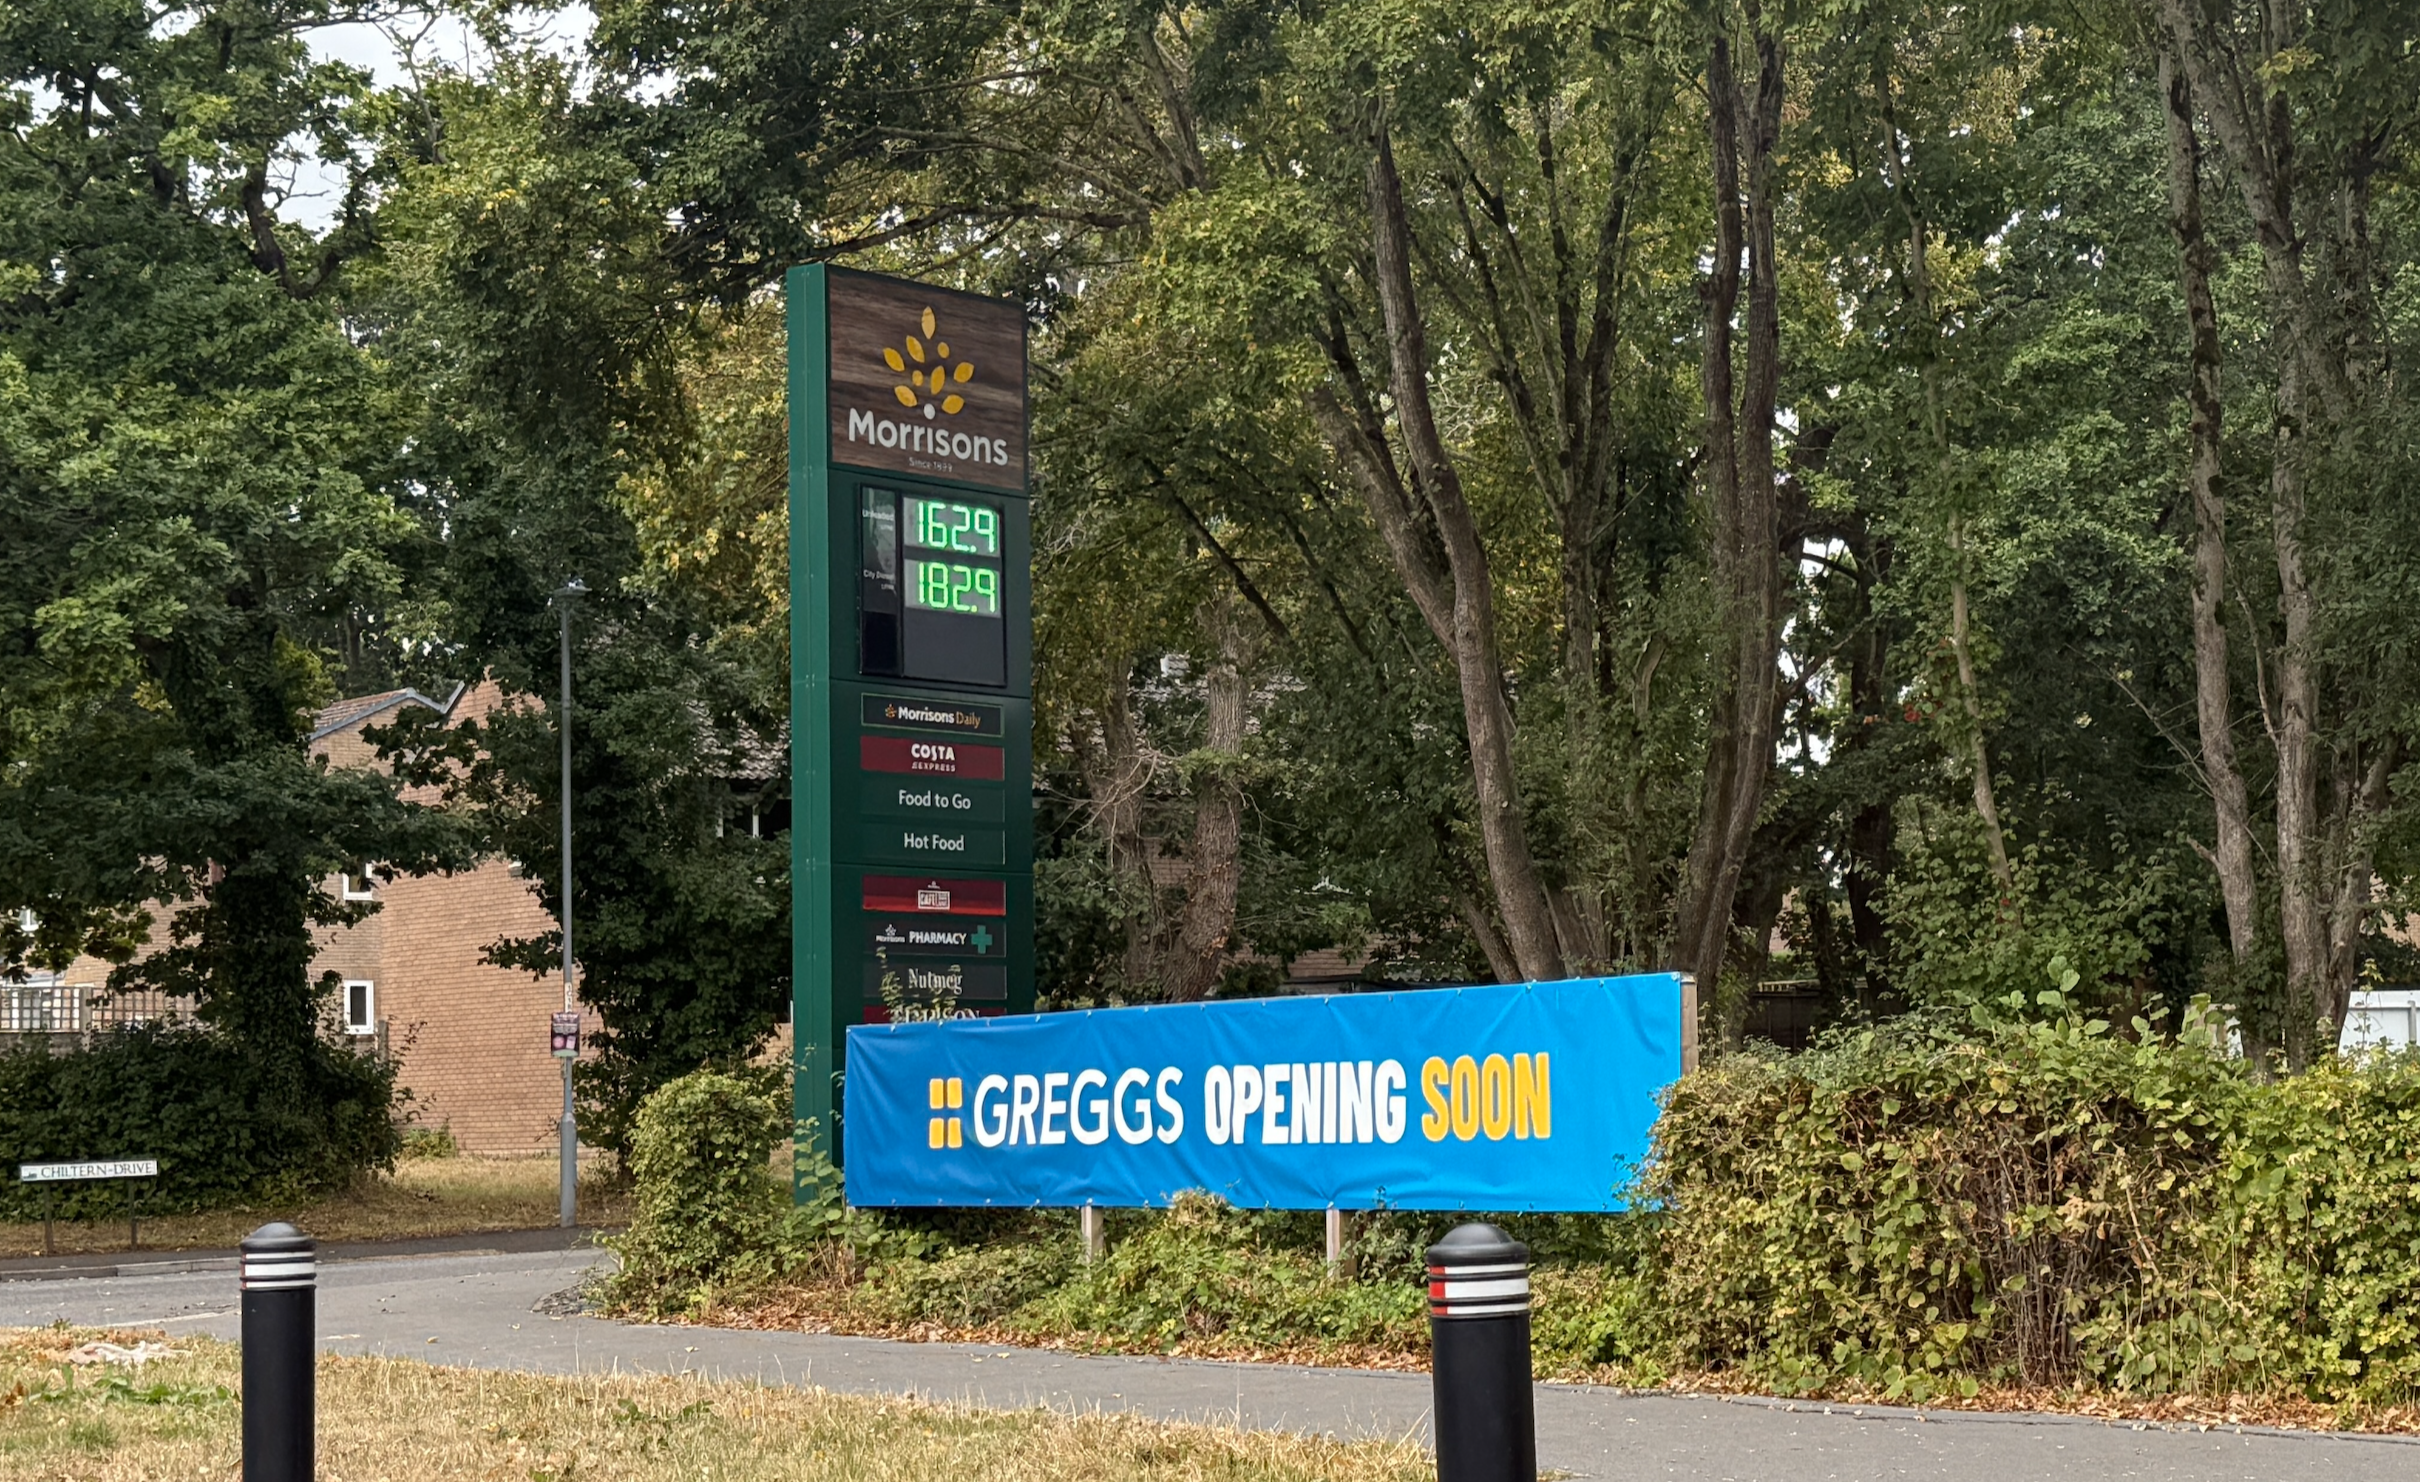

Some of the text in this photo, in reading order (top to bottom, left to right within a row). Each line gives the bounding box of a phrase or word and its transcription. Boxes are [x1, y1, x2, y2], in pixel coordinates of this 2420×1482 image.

[849, 404, 1009, 466] Morrisons
[898, 706, 982, 729] Morrisons Daily
[911, 743, 956, 761] COSTA
[899, 789, 971, 810] Food to Go
[904, 832, 965, 851] Hot Food
[909, 930, 967, 945] PHARMACY
[908, 968, 962, 995] Nutmeg
[974, 1052, 1551, 1148] GREGGS OPENING SOON
